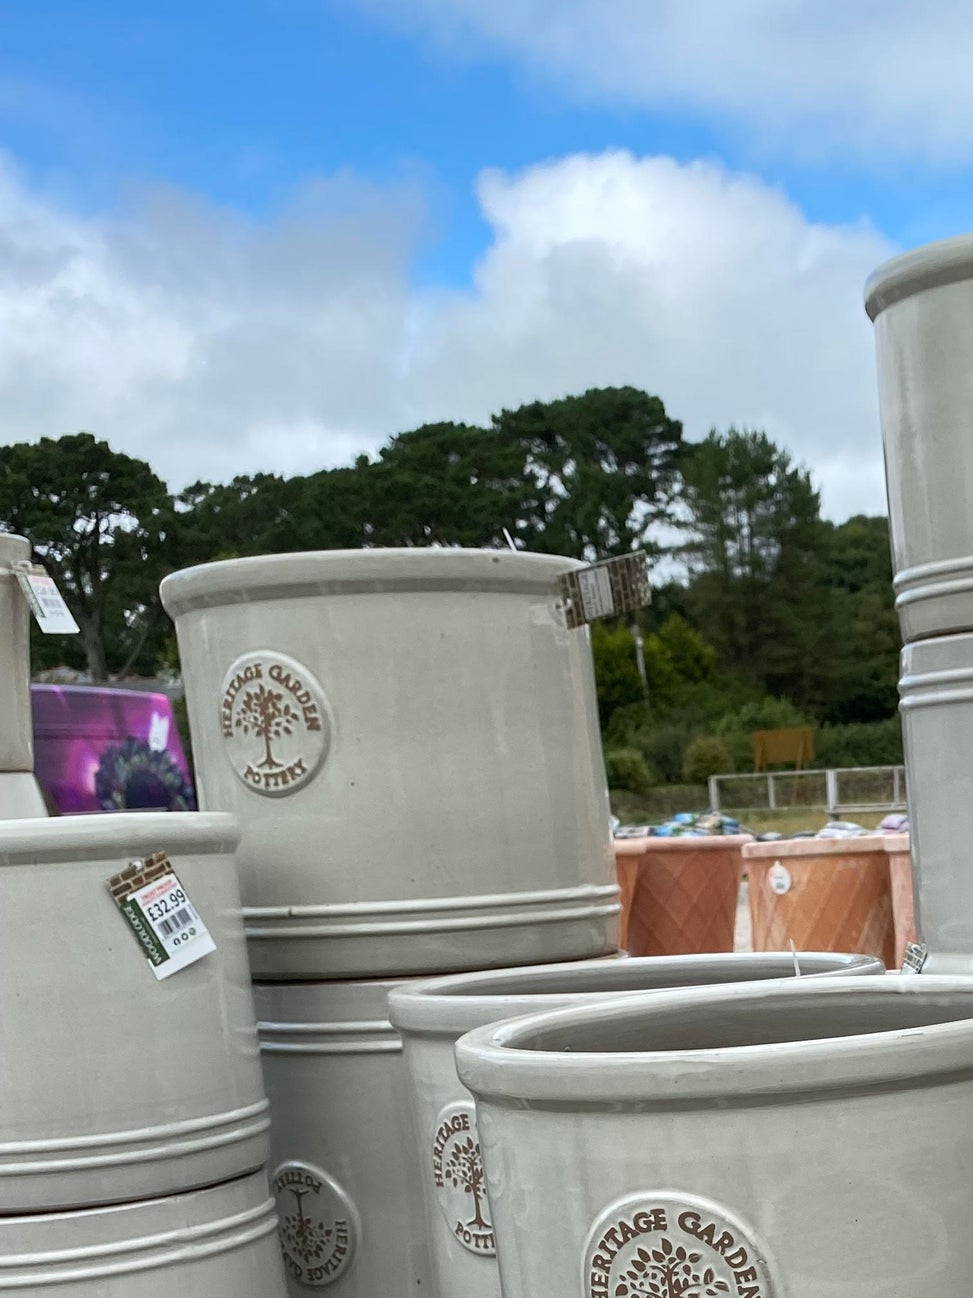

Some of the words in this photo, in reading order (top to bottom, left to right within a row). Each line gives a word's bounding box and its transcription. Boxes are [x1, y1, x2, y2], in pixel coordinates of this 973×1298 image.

[223, 663, 262, 738] HERITAGE
[269, 664, 321, 731] GARDEN
[244, 758, 307, 789] POTTERY
[147, 889, 186, 921] £32.99
[434, 1113, 470, 1188] HERITAGE
[307, 1221, 349, 1281] HERITAGE
[455, 1221, 495, 1249] POTT
